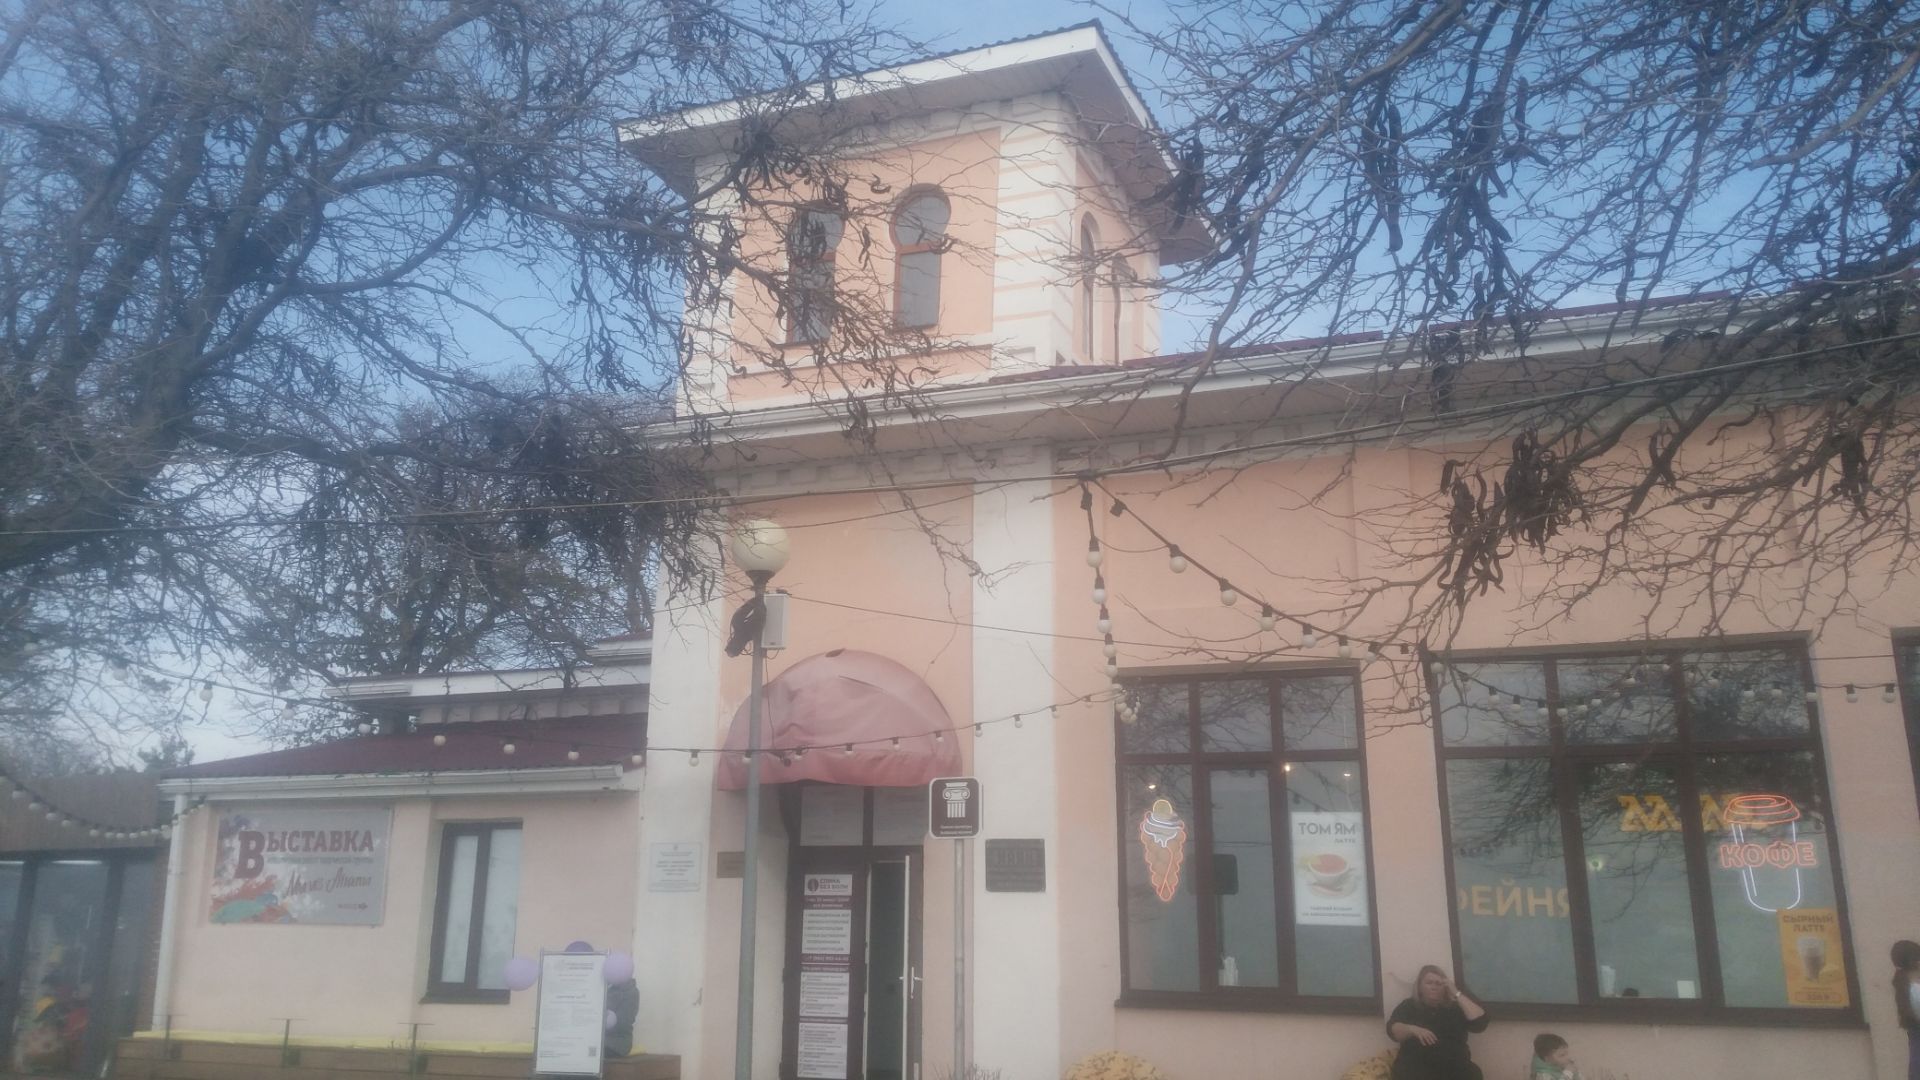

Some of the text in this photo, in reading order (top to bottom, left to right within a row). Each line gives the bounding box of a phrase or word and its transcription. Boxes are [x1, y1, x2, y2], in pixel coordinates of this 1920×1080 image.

[1298, 823, 1356, 835] ТОМ ЯМ
[234, 830, 374, 879] ВЫСТАВКА
[1720, 841, 1817, 869] КОФЕ
[1783, 912, 1834, 923] СЫРНЫЙ
